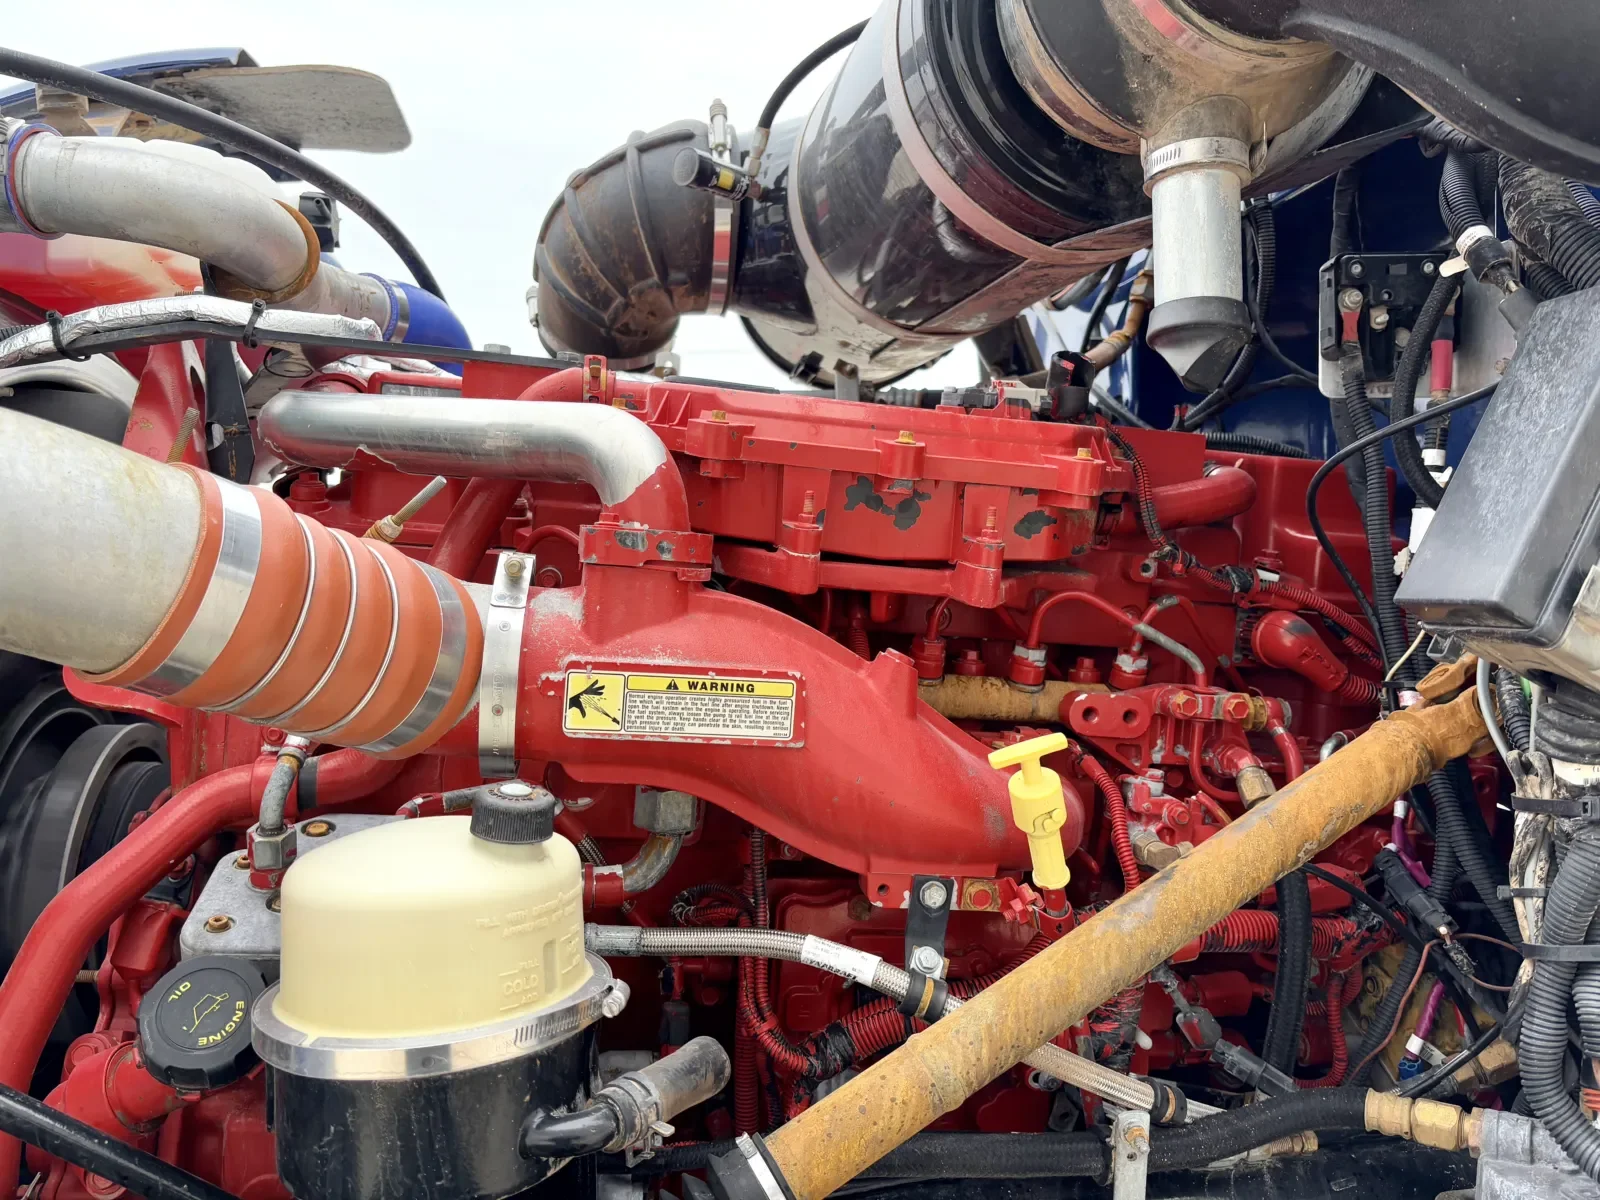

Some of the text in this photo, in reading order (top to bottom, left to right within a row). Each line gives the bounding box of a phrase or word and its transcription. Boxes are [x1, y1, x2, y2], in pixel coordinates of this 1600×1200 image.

[688, 681, 755, 693] WARNING
[168, 981, 191, 1003] OIL
[503, 974, 538, 995] COLD
[198, 1000, 244, 1046] ENGINE
